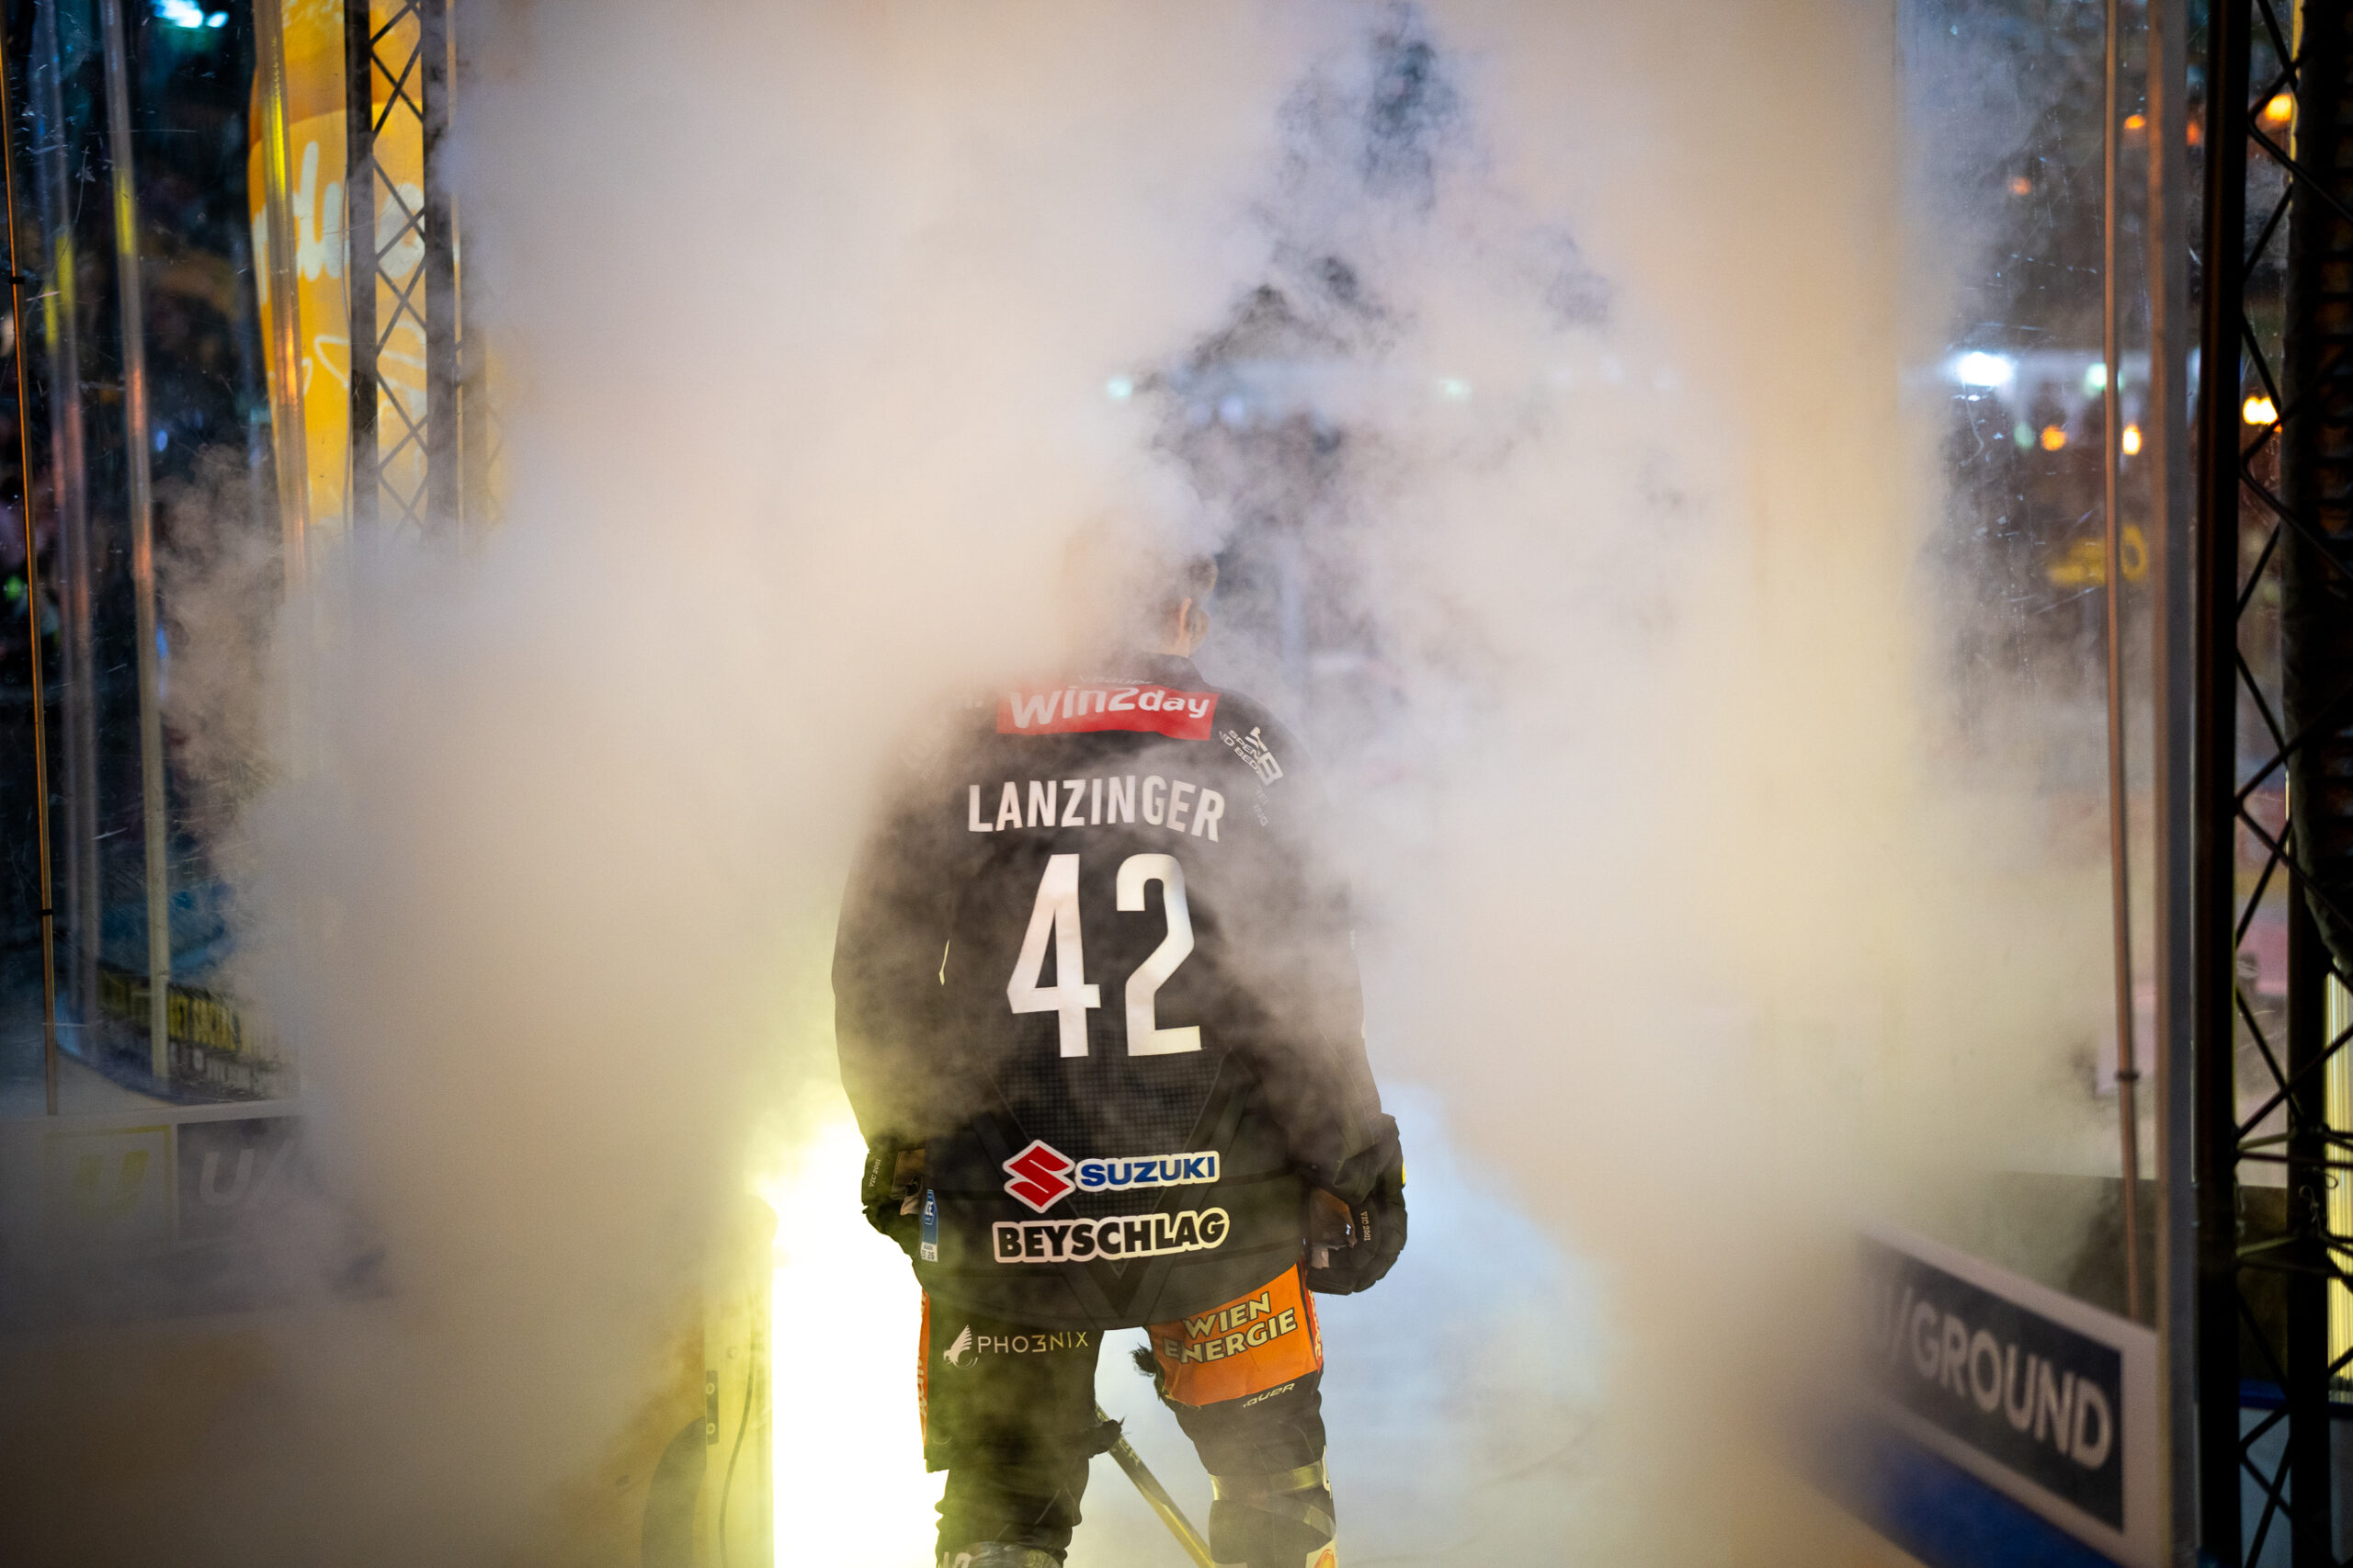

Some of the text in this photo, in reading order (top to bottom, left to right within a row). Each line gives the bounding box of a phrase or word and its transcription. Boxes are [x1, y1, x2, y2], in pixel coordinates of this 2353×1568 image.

[1011, 685, 1211, 729] win2day
[968, 774, 1225, 842] LANZINGER
[1007, 853, 1201, 1058] 42
[1080, 1156, 1215, 1187] SUZUKI
[997, 1207, 1225, 1258] BEYSCHLAG
[1163, 1307, 1298, 1364] ENERGIE
[1182, 1291, 1271, 1339] WIEN
[1243, 1382, 1295, 1408] AUER
